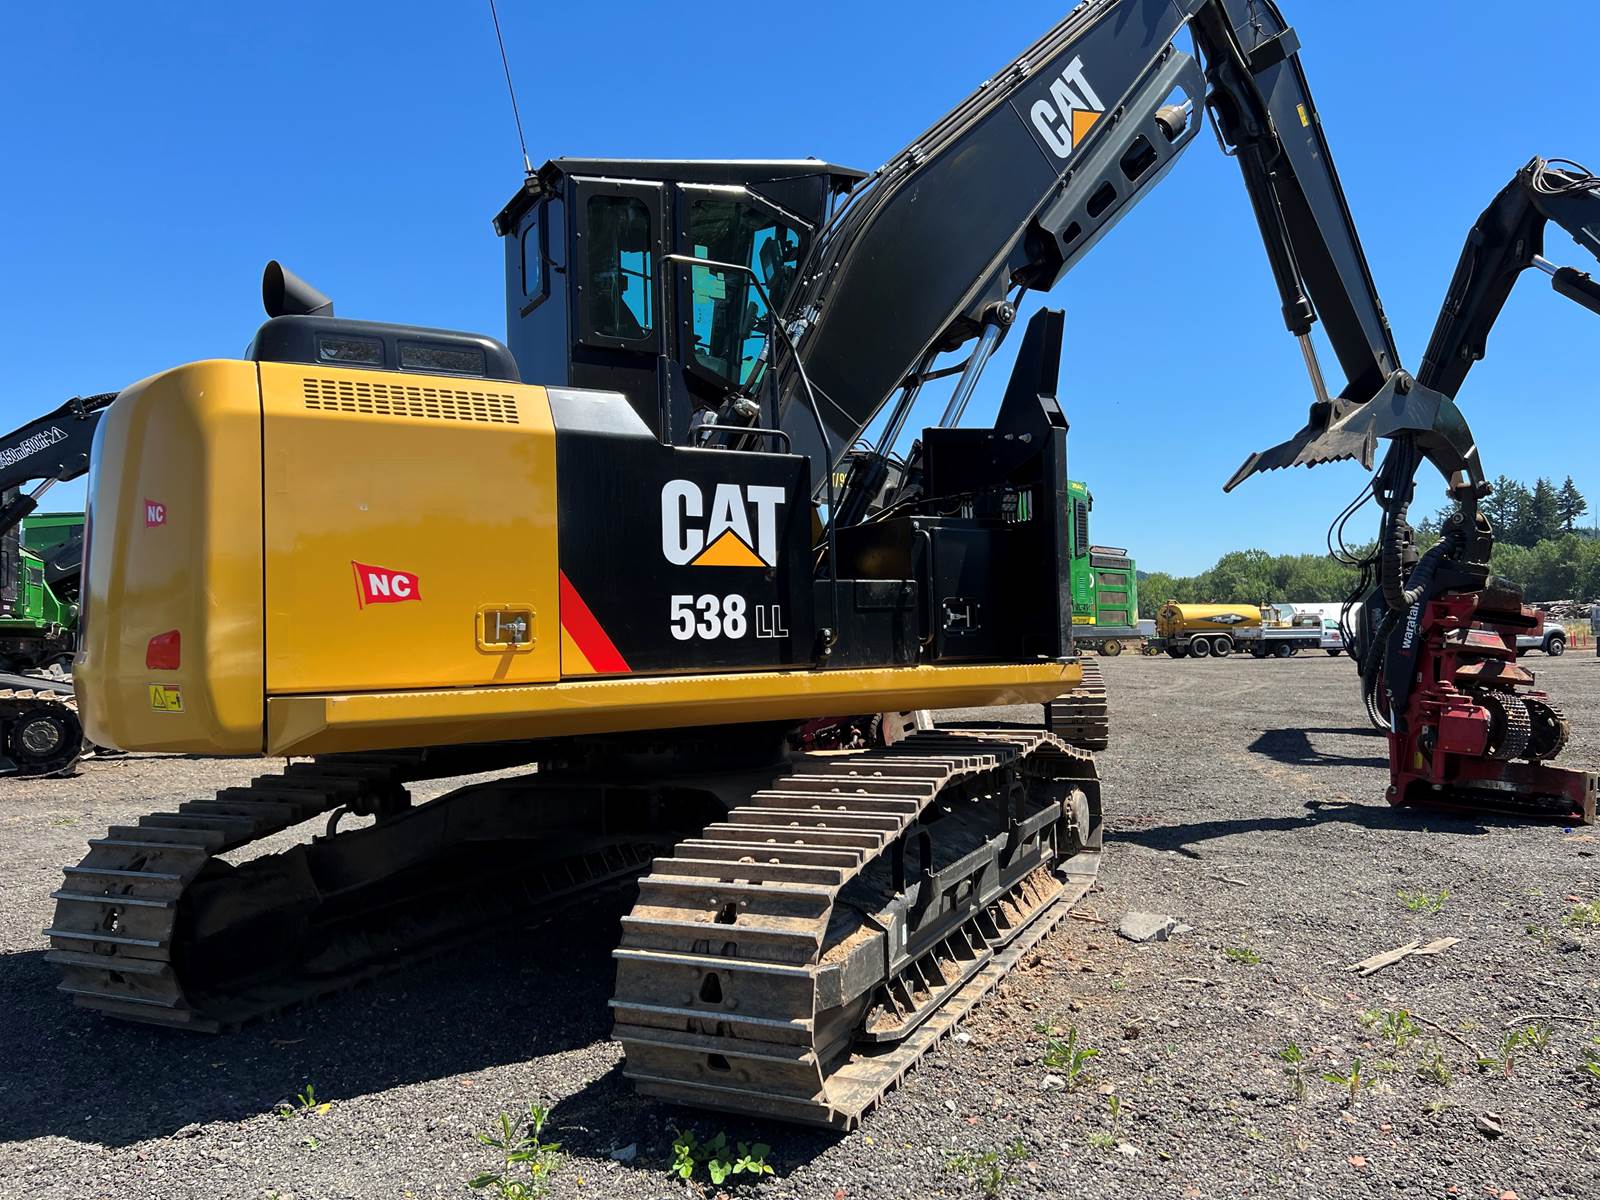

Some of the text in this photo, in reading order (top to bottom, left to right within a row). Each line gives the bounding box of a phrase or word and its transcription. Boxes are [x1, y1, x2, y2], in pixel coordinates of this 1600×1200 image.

[1030, 54, 1105, 158] CAT
[148, 505, 163, 522] NC
[661, 479, 785, 567] CAT
[368, 573, 411, 597] NC
[670, 594, 789, 640] 538 LL
